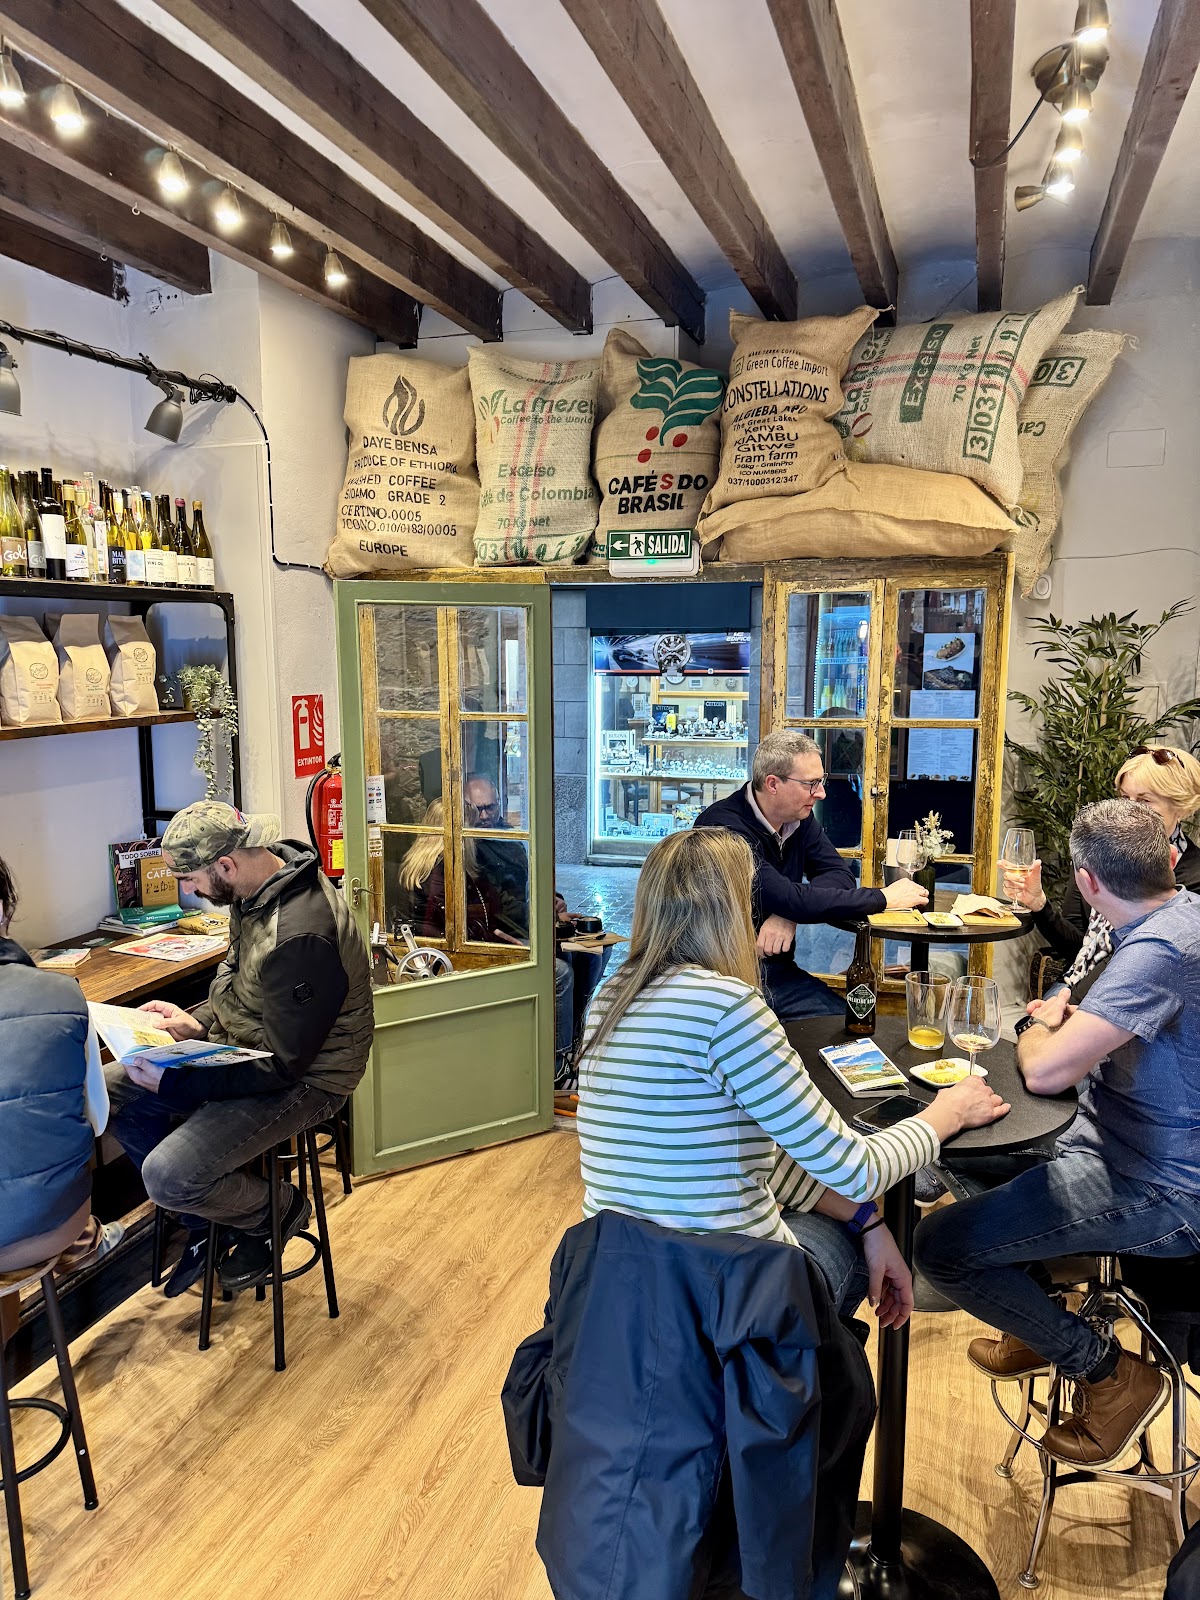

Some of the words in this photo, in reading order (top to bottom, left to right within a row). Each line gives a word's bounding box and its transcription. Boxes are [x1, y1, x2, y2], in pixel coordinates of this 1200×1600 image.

[746, 359, 769, 371] Green
[771, 356, 799, 370] Coffee
[801, 359, 828, 376] Import
[904, 330, 944, 406] Excelso
[953, 384, 967, 402] 70
[966, 335, 983, 359] Net
[722, 380, 830, 413] CONSTELLATIONS
[502, 397, 526, 415] La
[501, 415, 531, 424] Coffee
[547, 414, 562, 424] the
[565, 415, 593, 424] world
[747, 418, 770, 426] Great
[744, 424, 784, 435] Kenya
[395, 439, 438, 456] BENSA
[734, 432, 799, 447] KIAMBU
[737, 443, 795, 452] Gitwe
[390, 456, 406, 466] OF
[734, 454, 765, 463] Fram
[769, 451, 798, 460] farm
[498, 463, 556, 478] Excelso
[388, 474, 437, 490] COFFEE
[677, 474, 708, 490] DO
[388, 490, 430, 504] GRADE
[439, 494, 446, 506] 2
[497, 487, 514, 502] de
[519, 486, 595, 501] Colombia
[617, 492, 685, 515] BRASIL
[497, 517, 510, 530] 70
[530, 516, 551, 527] Net
[359, 540, 409, 557] EUROPE
[647, 534, 686, 554] SALIDA
[297, 755, 323, 767] EXTINTOR
[121, 852, 139, 860] TODO
[140, 850, 160, 858] SOBRE
